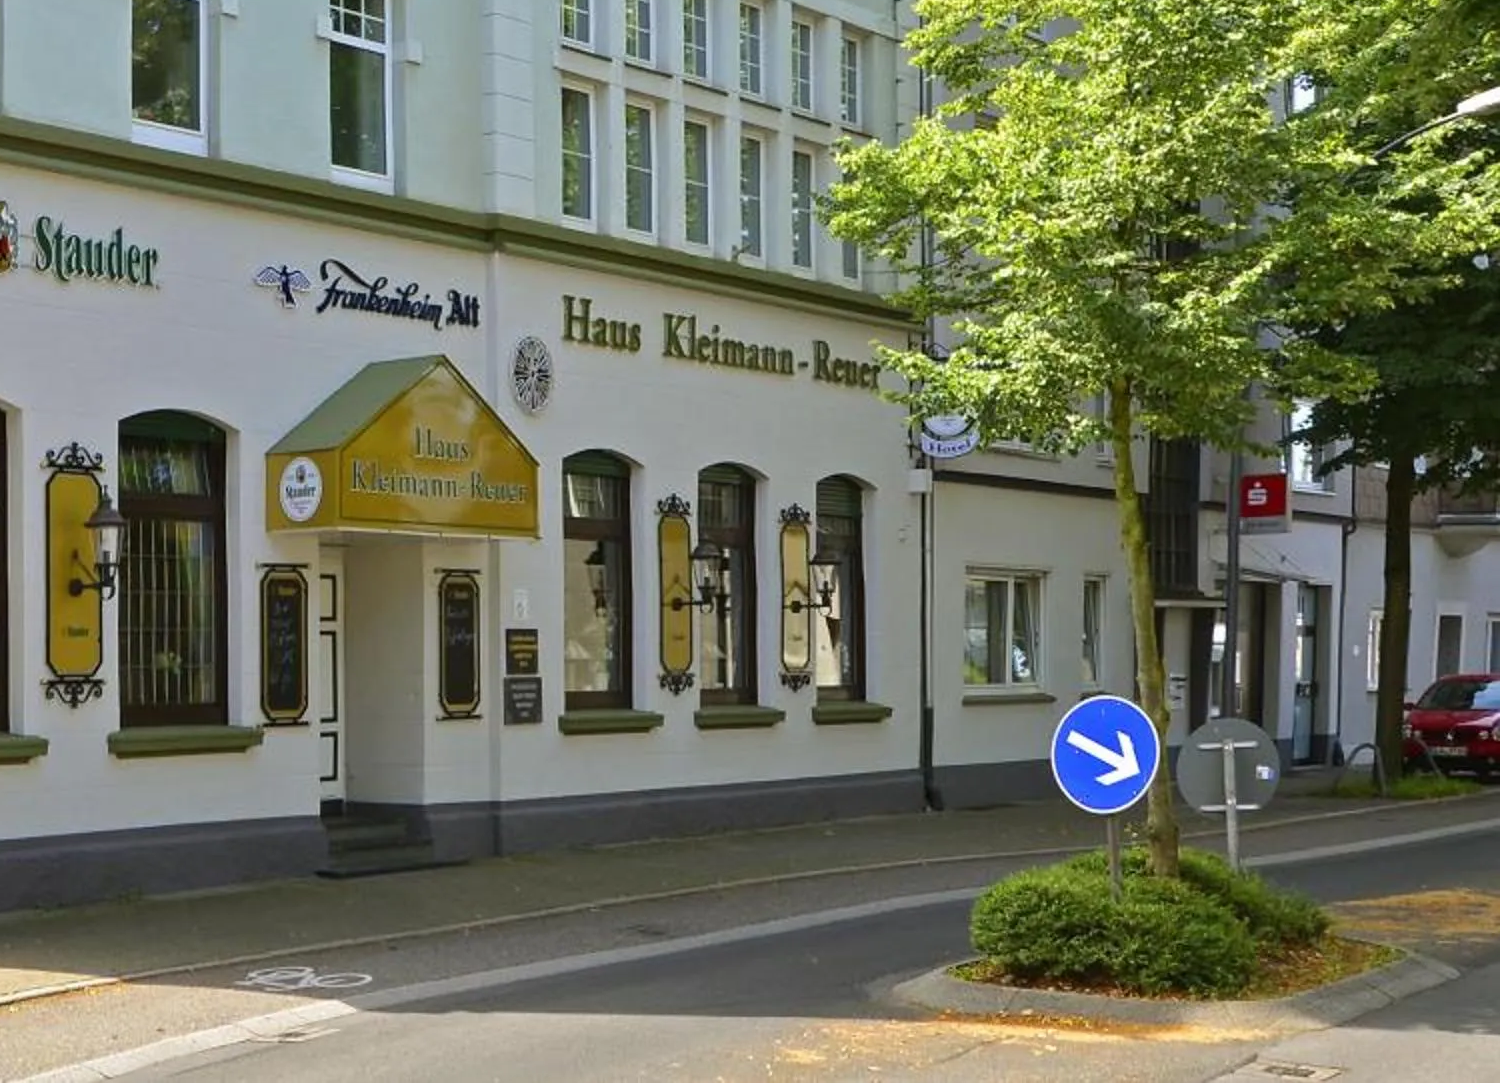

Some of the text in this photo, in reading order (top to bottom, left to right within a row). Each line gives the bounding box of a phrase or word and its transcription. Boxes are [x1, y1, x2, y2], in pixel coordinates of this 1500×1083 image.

[35, 216, 159, 286] Stauder
[316, 259, 480, 330] Frankenheim Alt
[562, 295, 641, 353] Haus
[414, 426, 469, 463] Haus
